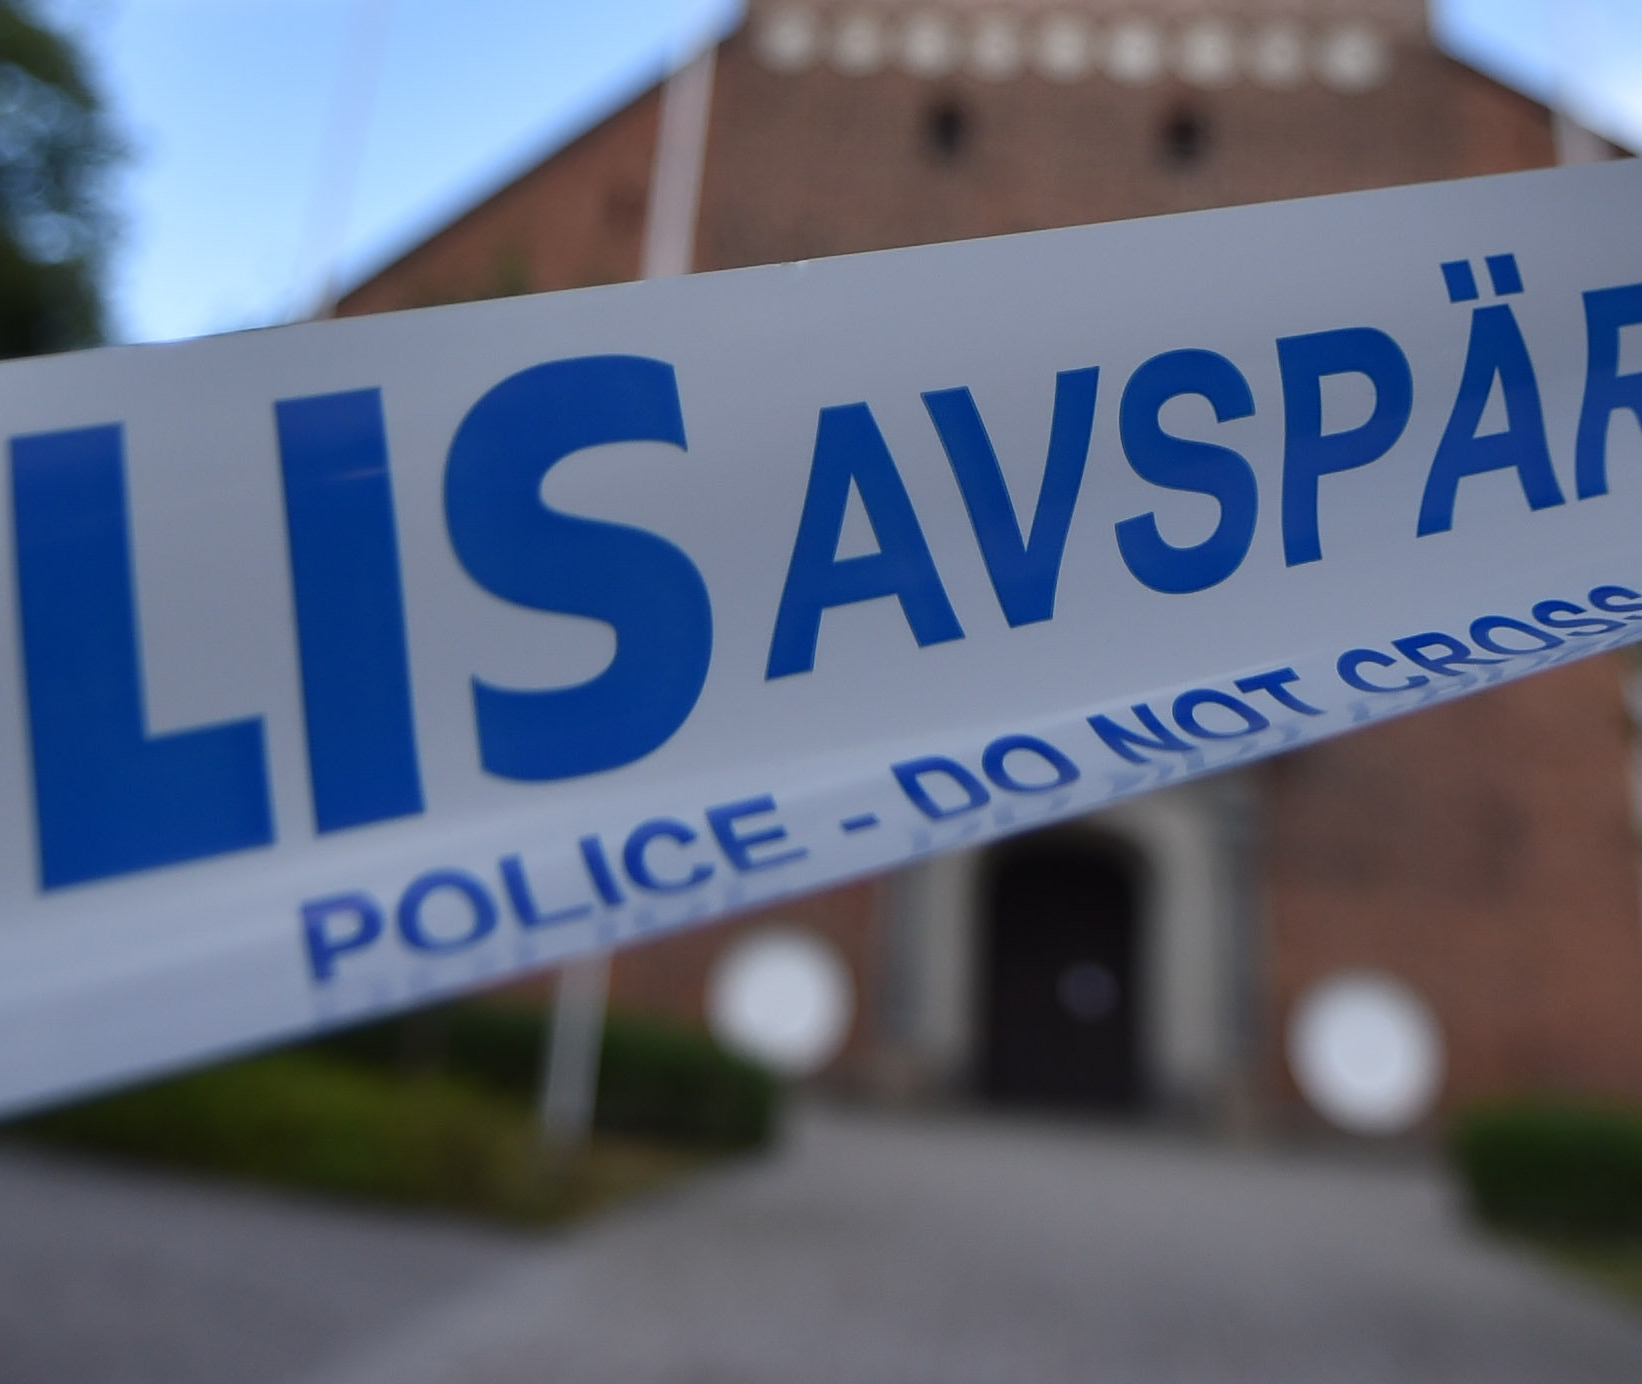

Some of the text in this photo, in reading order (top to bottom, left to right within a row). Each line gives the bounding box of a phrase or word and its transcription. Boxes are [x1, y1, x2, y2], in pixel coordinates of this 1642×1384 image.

[299, 792, 811, 986] POLICE
[839, 811, 882, 835] -
[889, 732, 1083, 822] DO
[1086, 666, 1328, 768] NOT
